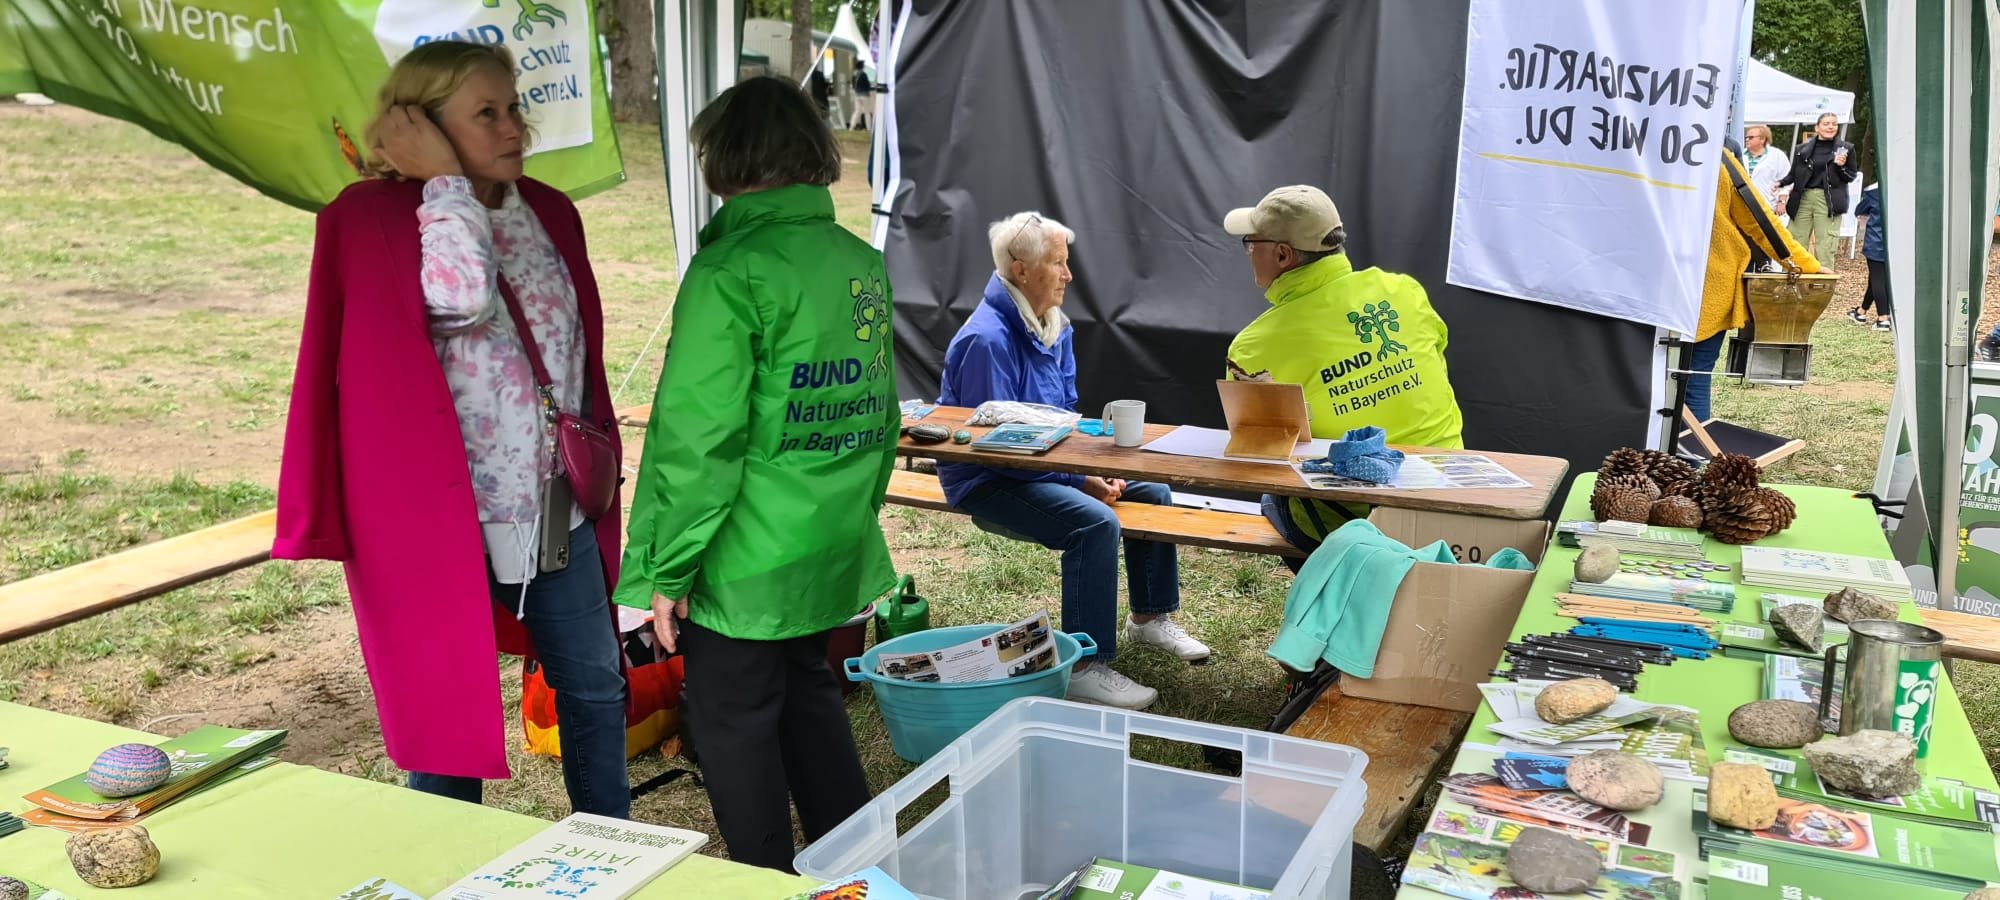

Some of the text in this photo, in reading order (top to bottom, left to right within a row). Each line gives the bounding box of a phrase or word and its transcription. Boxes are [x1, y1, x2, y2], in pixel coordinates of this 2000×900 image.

[139, 0, 298, 55] Mensch
[789, 357, 862, 390] BUND
[1320, 351, 1372, 385] BUND
[1328, 358, 1415, 398] Naturschutz
[1332, 372, 1423, 416] in Bayern e.V.
[779, 432, 801, 452] in
[804, 427, 873, 456] Bayern
[567, 819, 688, 846] KREISGRUPPE WUNSIEDEL
[568, 827, 668, 849] BUND NATURSCHUTZ
[544, 843, 642, 867] JAHRE
